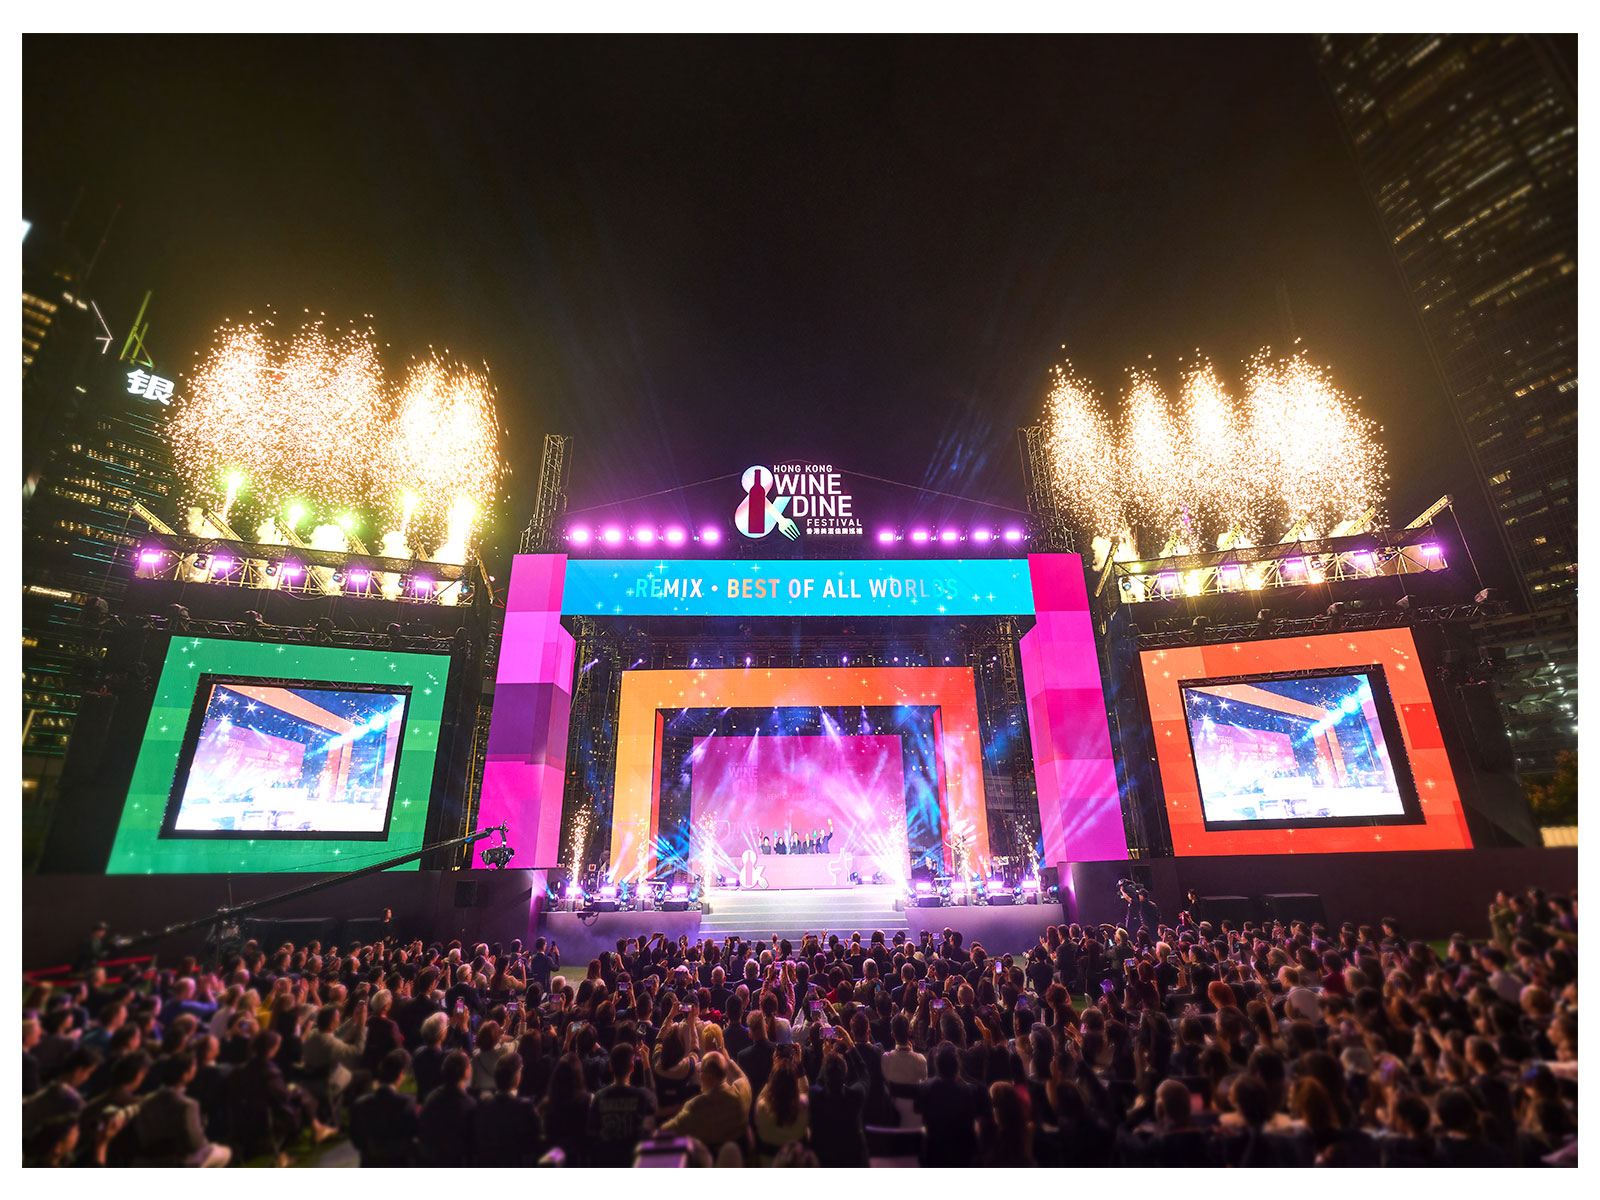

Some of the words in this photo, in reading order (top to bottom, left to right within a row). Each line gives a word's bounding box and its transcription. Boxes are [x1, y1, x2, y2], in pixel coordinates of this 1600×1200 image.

[127, 369, 175, 405] 銀
[773, 465, 801, 473] HONG
[805, 465, 833, 473] KONG
[773, 474, 842, 495] WINE
[792, 495, 853, 517] DINE
[806, 519, 862, 527] FESTIVAL
[635, 578, 703, 598] REMIX
[727, 578, 781, 598] BEST
[788, 578, 815, 599] OF
[822, 578, 862, 599] ALL
[868, 578, 958, 599] WORLDS
[728, 766, 758, 778] WINE
